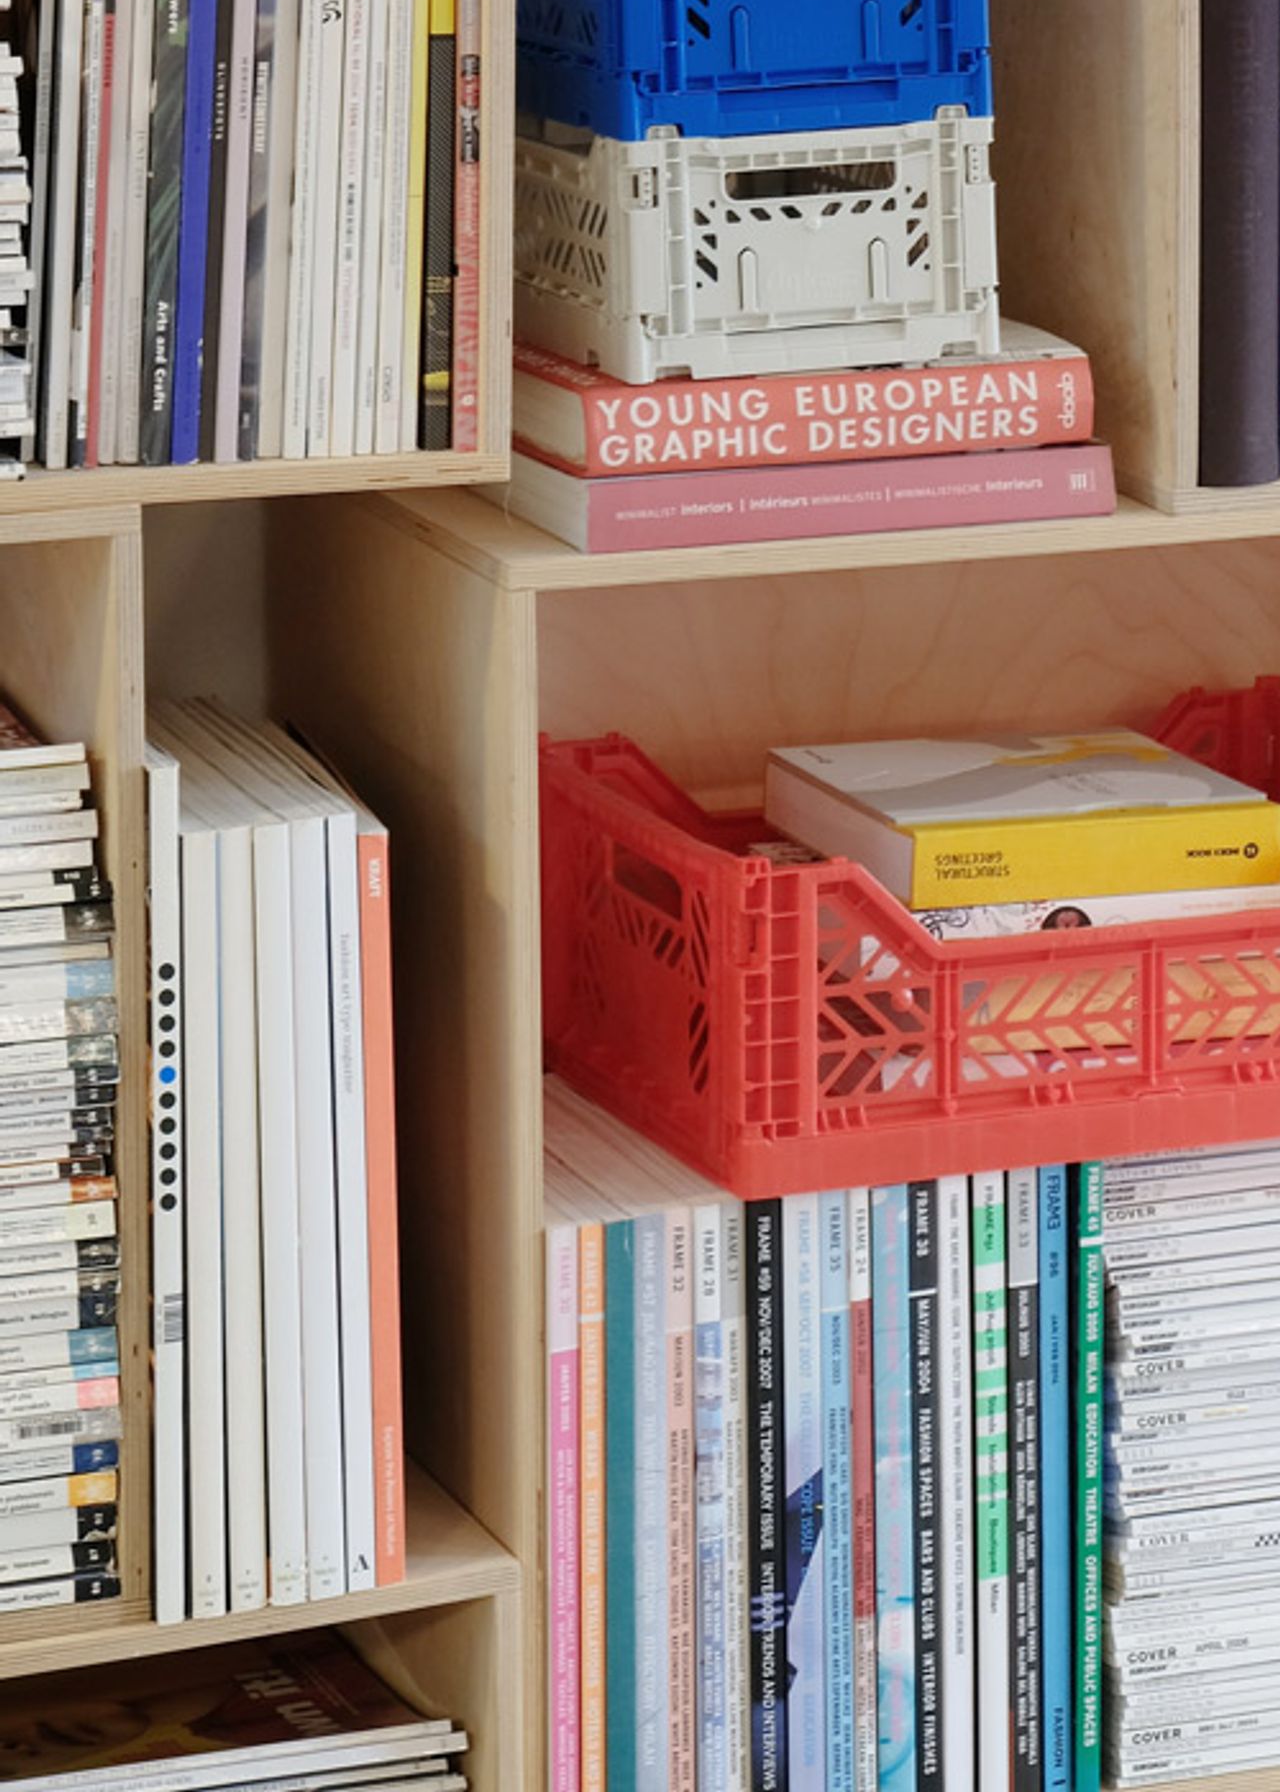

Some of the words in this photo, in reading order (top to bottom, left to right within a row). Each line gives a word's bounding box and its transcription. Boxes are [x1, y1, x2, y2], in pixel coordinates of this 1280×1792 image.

[156, 301, 168, 332] Arts
[155, 338, 168, 363] and
[152, 367, 167, 411] Crafts
[597, 387, 771, 431] YOUNG
[795, 369, 1040, 419] EUROPEAN
[598, 421, 787, 468] GRAPHIC
[807, 404, 1040, 453] DESIGNERS
[341, 983, 352, 1000] art
[916, 1190, 928, 1232] FRAME
[1019, 1182, 1029, 1224] FRAME
[1046, 1174, 1061, 1230] FRAM3
[1087, 1165, 1100, 1213] FRAME
[829, 1205, 841, 1250] FRAME
[856, 1208, 866, 1252] FRAME
[1105, 1207, 1157, 1223] COVER
[673, 1226, 684, 1270] FRAME
[703, 1229, 715, 1274] FRAME
[727, 1218, 738, 1261] FRAME
[758, 1215, 771, 1261] FRAME
[673, 1276, 684, 1292] 32
[759, 1297, 772, 1354] NOV/DEC
[1085, 1351, 1099, 1394] MILAN
[1134, 1359, 1186, 1376] COVER
[760, 1401, 773, 1428] THE
[1137, 1413, 1188, 1428] COVER
[1084, 1403, 1099, 1478] EDUCATION
[760, 1430, 774, 1511] TEMPORARY
[761, 1513, 774, 1550] ISSUE
[1084, 1487, 1098, 1546] THEATRE
[921, 1528, 935, 1564] BARS
[762, 1561, 775, 1624] INTERIOR
[921, 1568, 935, 1594] AND
[989, 1583, 1000, 1614] Milan
[1084, 1555, 1098, 1612] OFFICES
[921, 1596, 935, 1640] CLUBS
[1084, 1615, 1098, 1643] AND
[762, 1626, 775, 1678] TRENDS
[1083, 1645, 1097, 1693] PUBLIC
[1126, 1647, 1178, 1665] COVER
[763, 1679, 775, 1708] AND
[922, 1650, 936, 1711] INTERIOR
[1082, 1695, 1097, 1748] SPACES
[1131, 1727, 1182, 1745] COVER
[763, 1710, 777, 1790] INTERVIEWS
[923, 1714, 937, 1776] FINISHES
